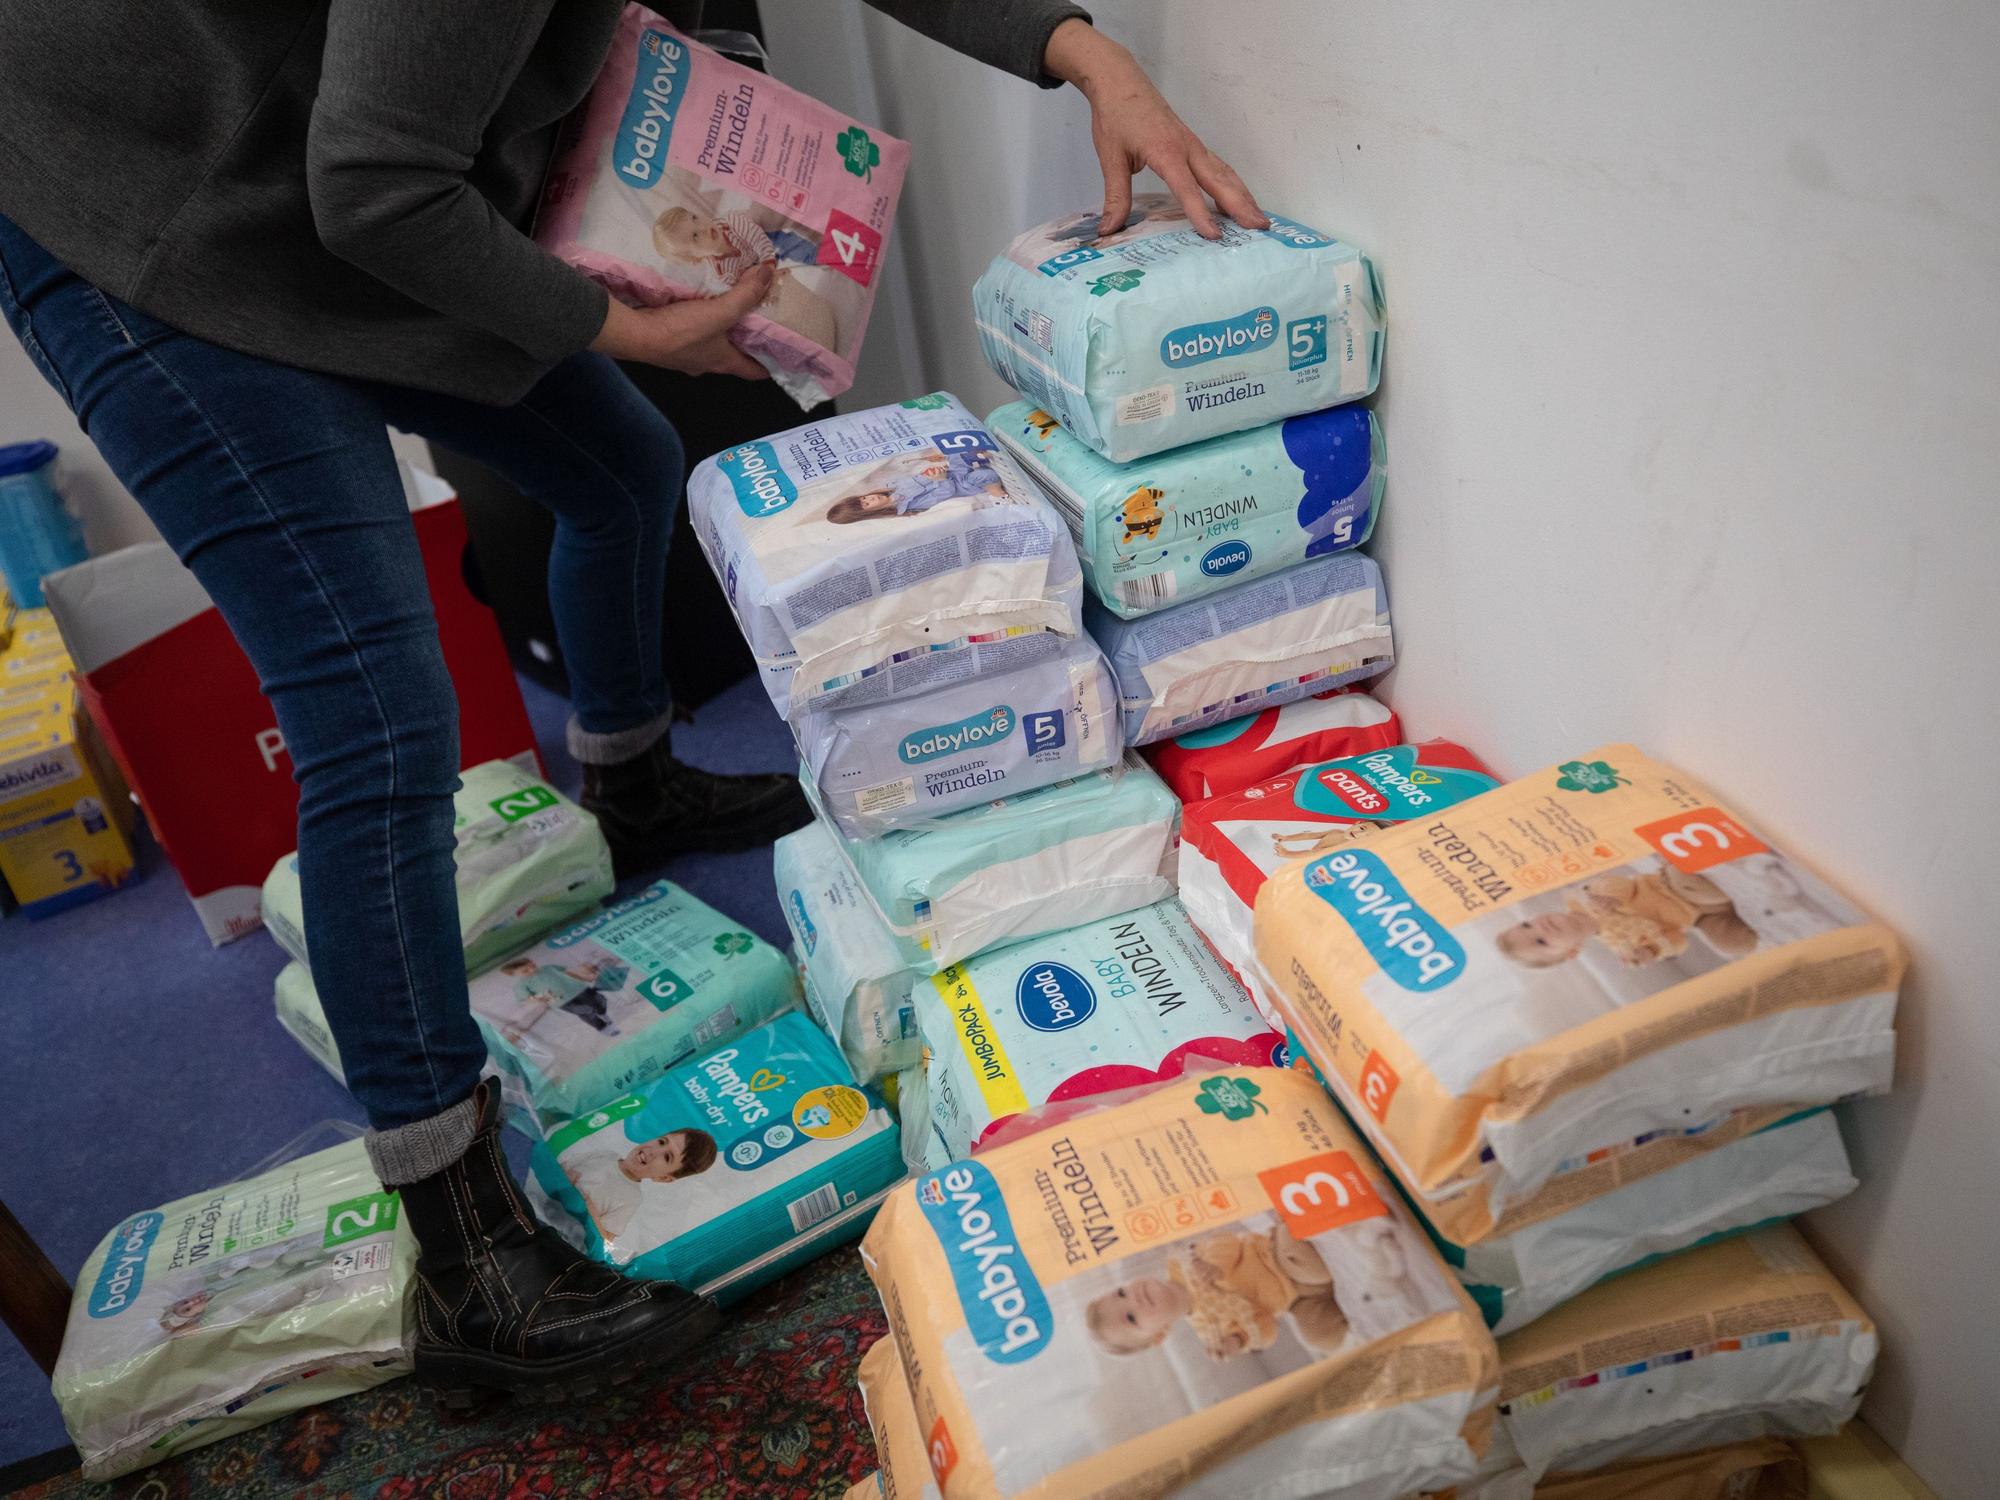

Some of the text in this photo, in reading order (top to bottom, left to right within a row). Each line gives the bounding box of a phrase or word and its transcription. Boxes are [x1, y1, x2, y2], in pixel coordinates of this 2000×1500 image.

[622, 40, 682, 182] babylove
[697, 89, 729, 170] Premium-
[715, 84, 754, 176] Windeln
[831, 229, 865, 265] 4
[1168, 320, 1273, 361] babylove
[1291, 321, 1325, 358] 5+
[1186, 382, 1266, 413] Windeln
[789, 443, 818, 481] Premium-
[803, 427, 841, 474] Windeln
[940, 434, 979, 449] 5
[736, 445, 788, 513] babylove
[1184, 495, 1258, 529] WINDELN
[1205, 518, 1240, 538] BABY
[1334, 515, 1353, 543] 5
[1207, 548, 1247, 573] bevola
[905, 717, 1009, 759] babylove
[1034, 716, 1056, 743] 5
[0, 761, 64, 789] ebivita
[925, 759, 989, 783] Premium-
[926, 768, 1006, 798] Windeln
[1321, 769, 1382, 811] pants
[1357, 752, 1433, 807] Pampers
[500, 793, 541, 816] 2
[1660, 820, 1731, 860] 3
[54, 850, 83, 883] 3
[1417, 845, 1486, 913] Premium-
[1427, 821, 1514, 903] Windeln
[1329, 853, 1456, 985] babylove
[650, 976, 677, 998] 6
[1089, 958, 1137, 999] BABY
[1110, 922, 1188, 1018] WINDELN
[1034, 968, 1076, 1025] bevola
[959, 1002, 1006, 1081] JUMBOPACK
[684, 1076, 729, 1127] baby-dry
[697, 1048, 769, 1125] Pampers
[1365, 1071, 1387, 1111] 3
[1051, 1137, 1123, 1255] Windeln
[1280, 1170, 1350, 1217] 3
[332, 1202, 378, 1237] 2
[1034, 1168, 1087, 1267] Premium-
[98, 1215, 154, 1312] babyove
[945, 1167, 1041, 1355] babylove
